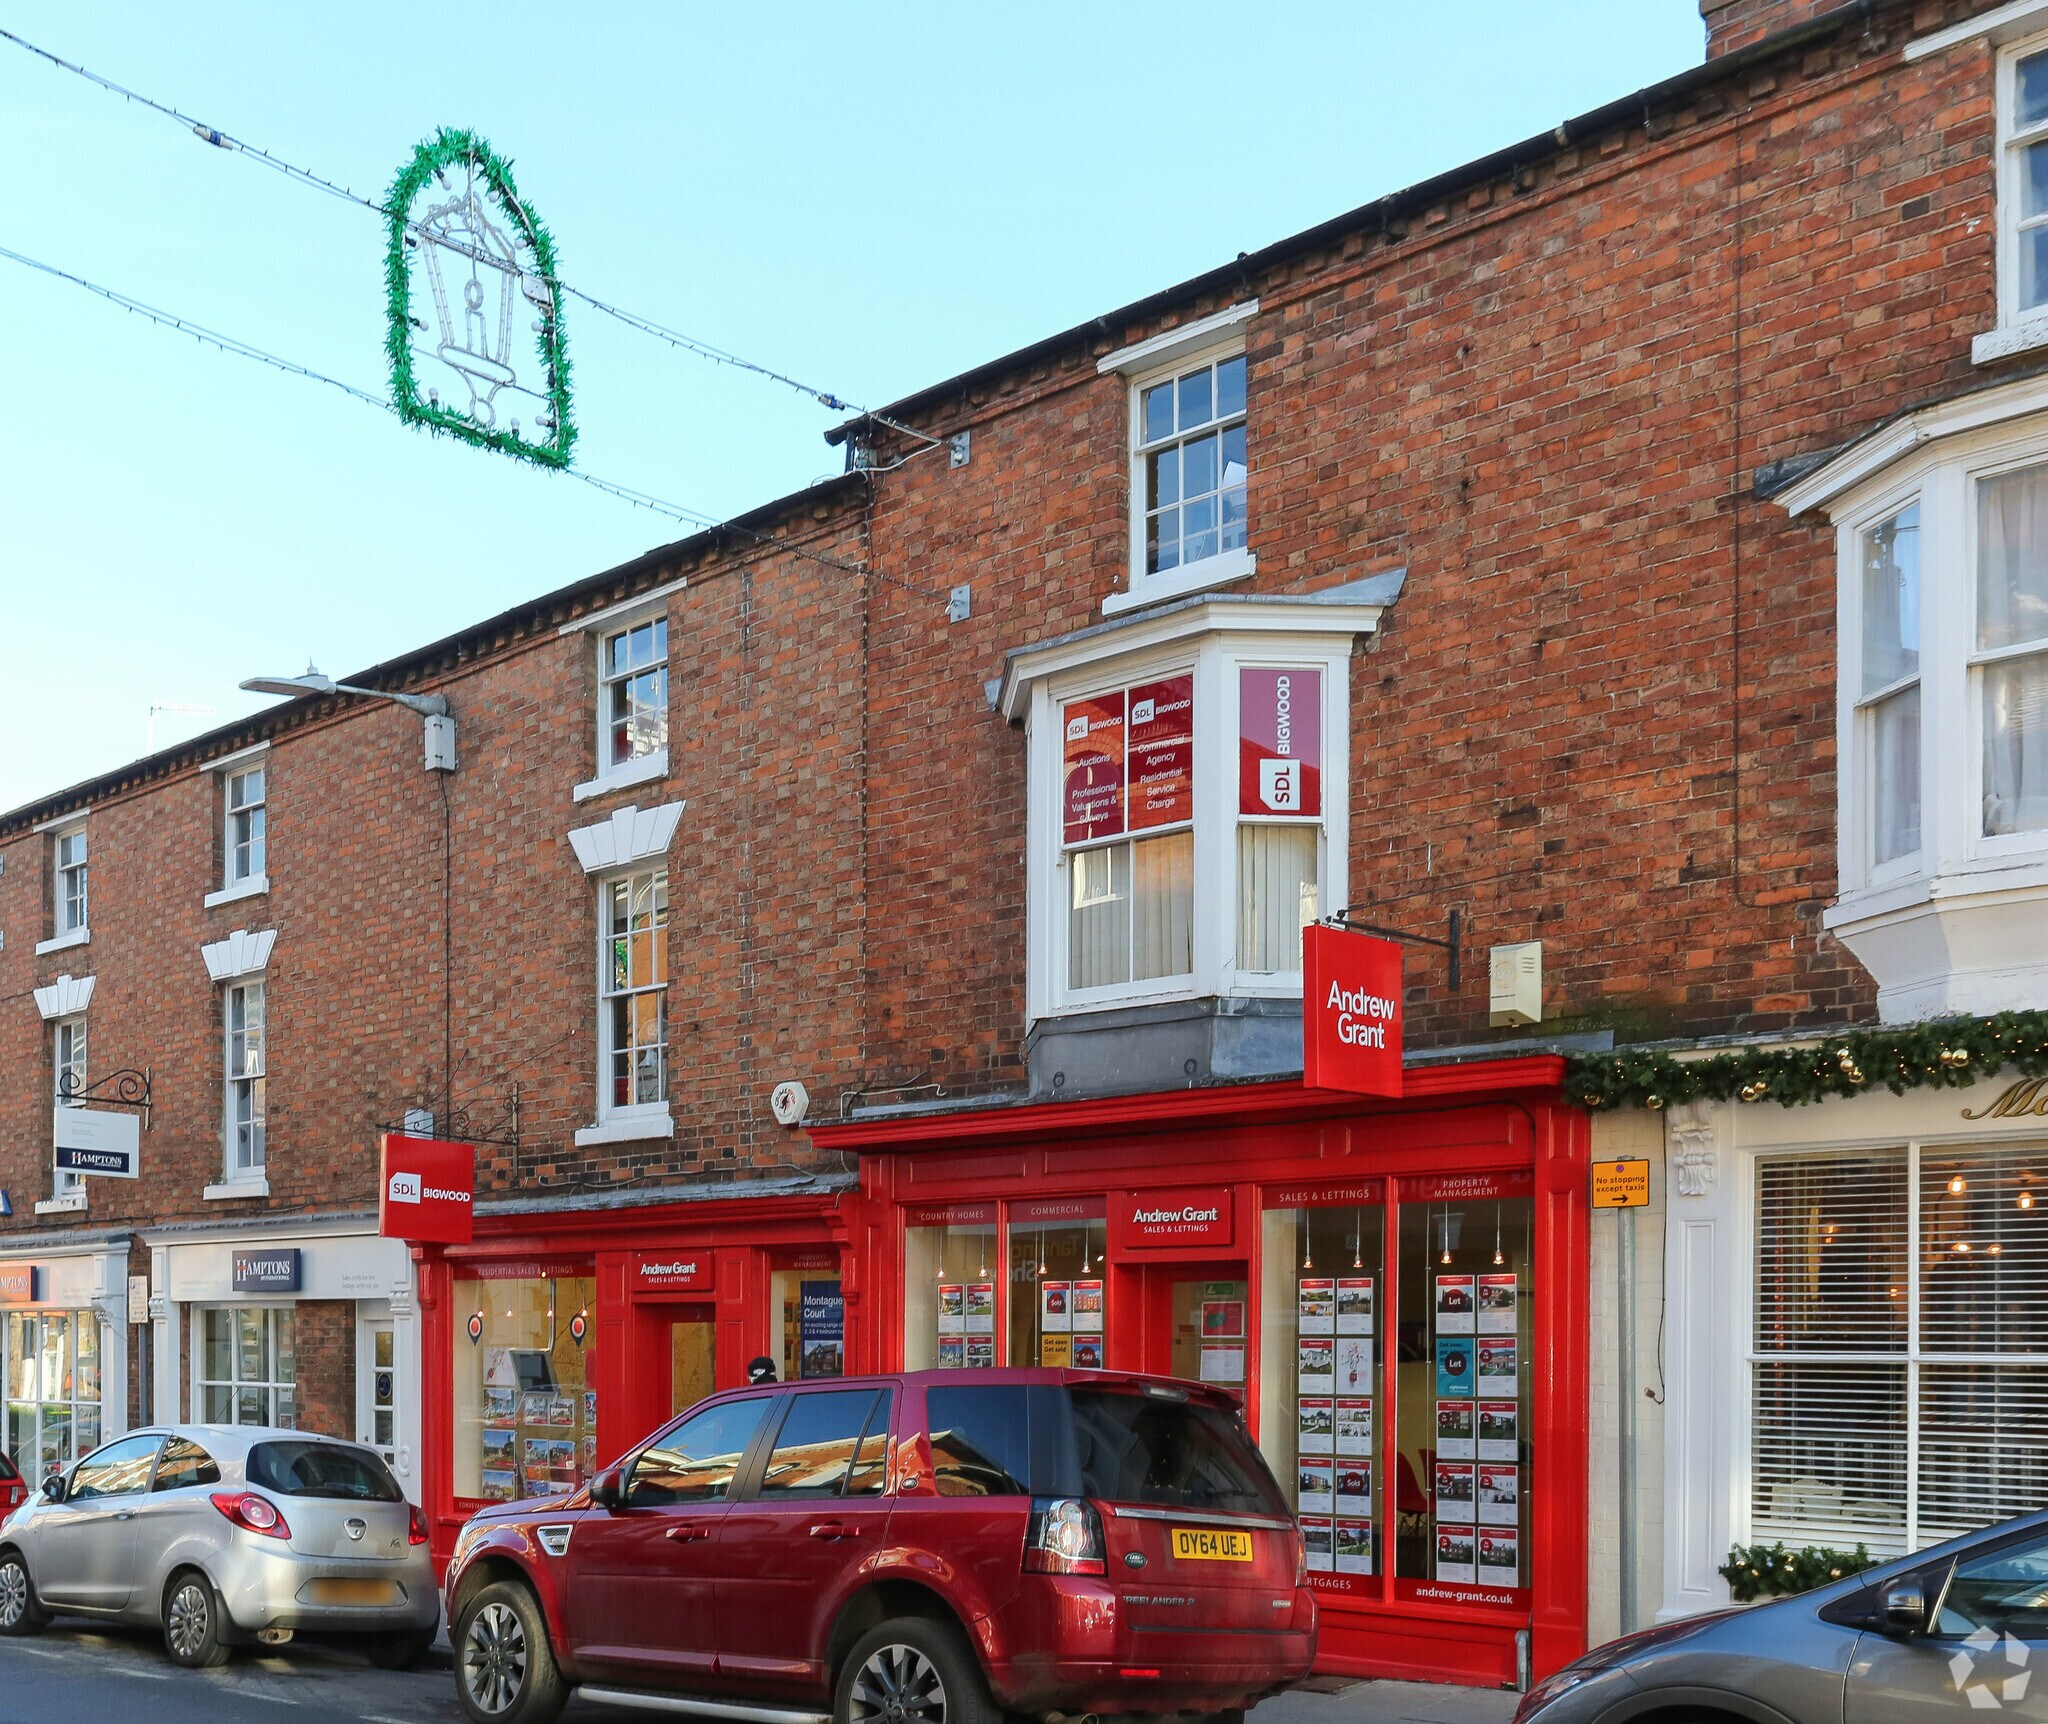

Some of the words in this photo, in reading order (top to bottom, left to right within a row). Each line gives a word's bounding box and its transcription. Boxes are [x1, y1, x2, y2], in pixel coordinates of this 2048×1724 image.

[1134, 708, 1151, 718] SDL
[1156, 699, 1190, 714] BIGWOOD
[1277, 676, 1290, 754] BIGWOOD
[1069, 725, 1085, 736] SDL
[1089, 716, 1122, 730] BIGWOOD
[1138, 734, 1184, 754] Commercial
[1078, 754, 1110, 768] Auctions
[1146, 752, 1176, 766] Agency
[1140, 768, 1182, 784] Residential
[1072, 782, 1117, 799] Professional
[1146, 784, 1176, 796] Service
[1275, 766, 1289, 803] SDL
[1072, 799, 1109, 812] Valuations
[1110, 796, 1116, 804] &
[1146, 796, 1176, 810] Charge
[1080, 811, 1108, 824] Surveys
[1326, 980, 1395, 1020] Andrew
[1338, 1012, 1385, 1049] Grant
[72, 1152, 122, 1165] HAMPTONS
[1444, 1178, 1490, 1188] PROPERTY
[1610, 1176, 1645, 1184] stopping
[393, 1182, 416, 1196] SDL
[423, 1188, 471, 1202] BIGWOOD
[1280, 1192, 1308, 1202] SALES
[1312, 1192, 1318, 1200] &
[1322, 1189, 1370, 1200] LETTINGS
[1434, 1186, 1499, 1198] MANAGEMENT
[920, 1212, 955, 1221] COUNTRY
[957, 1210, 984, 1220] HOMES
[1030, 1206, 1084, 1216] COMMERCIAL
[1132, 1208, 1181, 1223] Andrew
[1182, 1206, 1218, 1222] Grant
[1144, 1226, 1165, 1234] SALES
[1174, 1224, 1209, 1232] LETTINGS
[236, 1259, 290, 1282] HAMPTONS
[478, 1266, 515, 1276] RESIDENTIAL
[517, 1266, 536, 1275] SALES
[640, 1262, 672, 1275] Andrew
[673, 1262, 696, 1274] Grant
[804, 1296, 843, 1308] Montague
[1051, 1298, 1062, 1307] Sold
[1448, 1296, 1461, 1305] Let
[804, 1308, 826, 1318] Court
[1347, 1478, 1360, 1487] Sold
[1180, 1532, 1218, 1554] OY64
[1220, 1534, 1247, 1556] UEJ
[1306, 1576, 1351, 1590] RTGAGES
[1416, 1587, 1513, 1604] andrew-grant.co.uk
